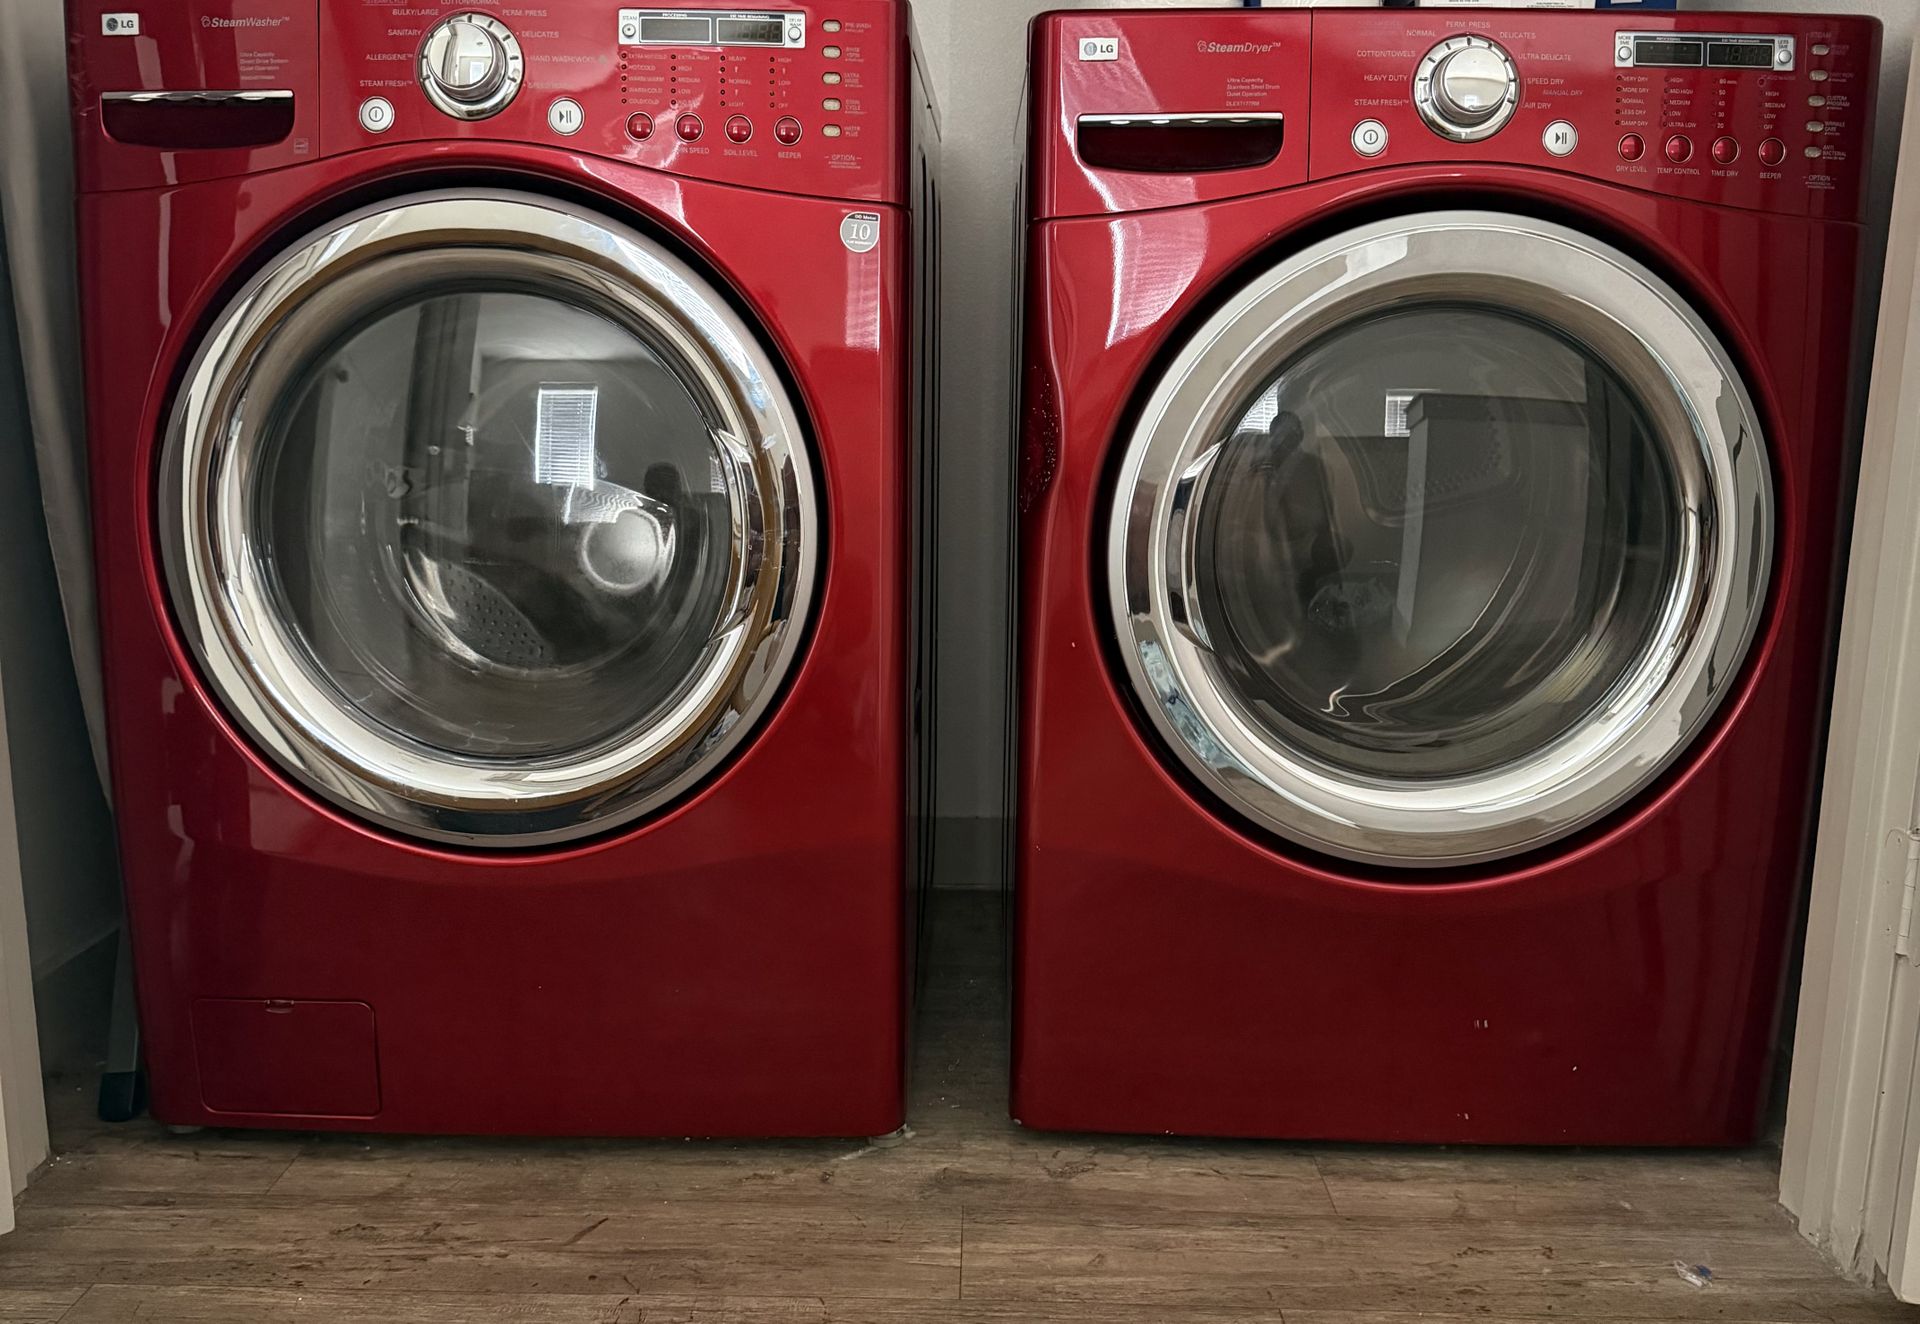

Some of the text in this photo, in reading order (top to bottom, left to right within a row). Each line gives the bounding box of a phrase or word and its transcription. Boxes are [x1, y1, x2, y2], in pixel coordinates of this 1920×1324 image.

[392, 8, 439, 16] BULKY/LARGE
[525, 9, 548, 17] PRESS
[1406, 29, 1436, 37] NORMAL
[1500, 31, 1536, 39] DELICATES
[850, 223, 870, 240] 10
